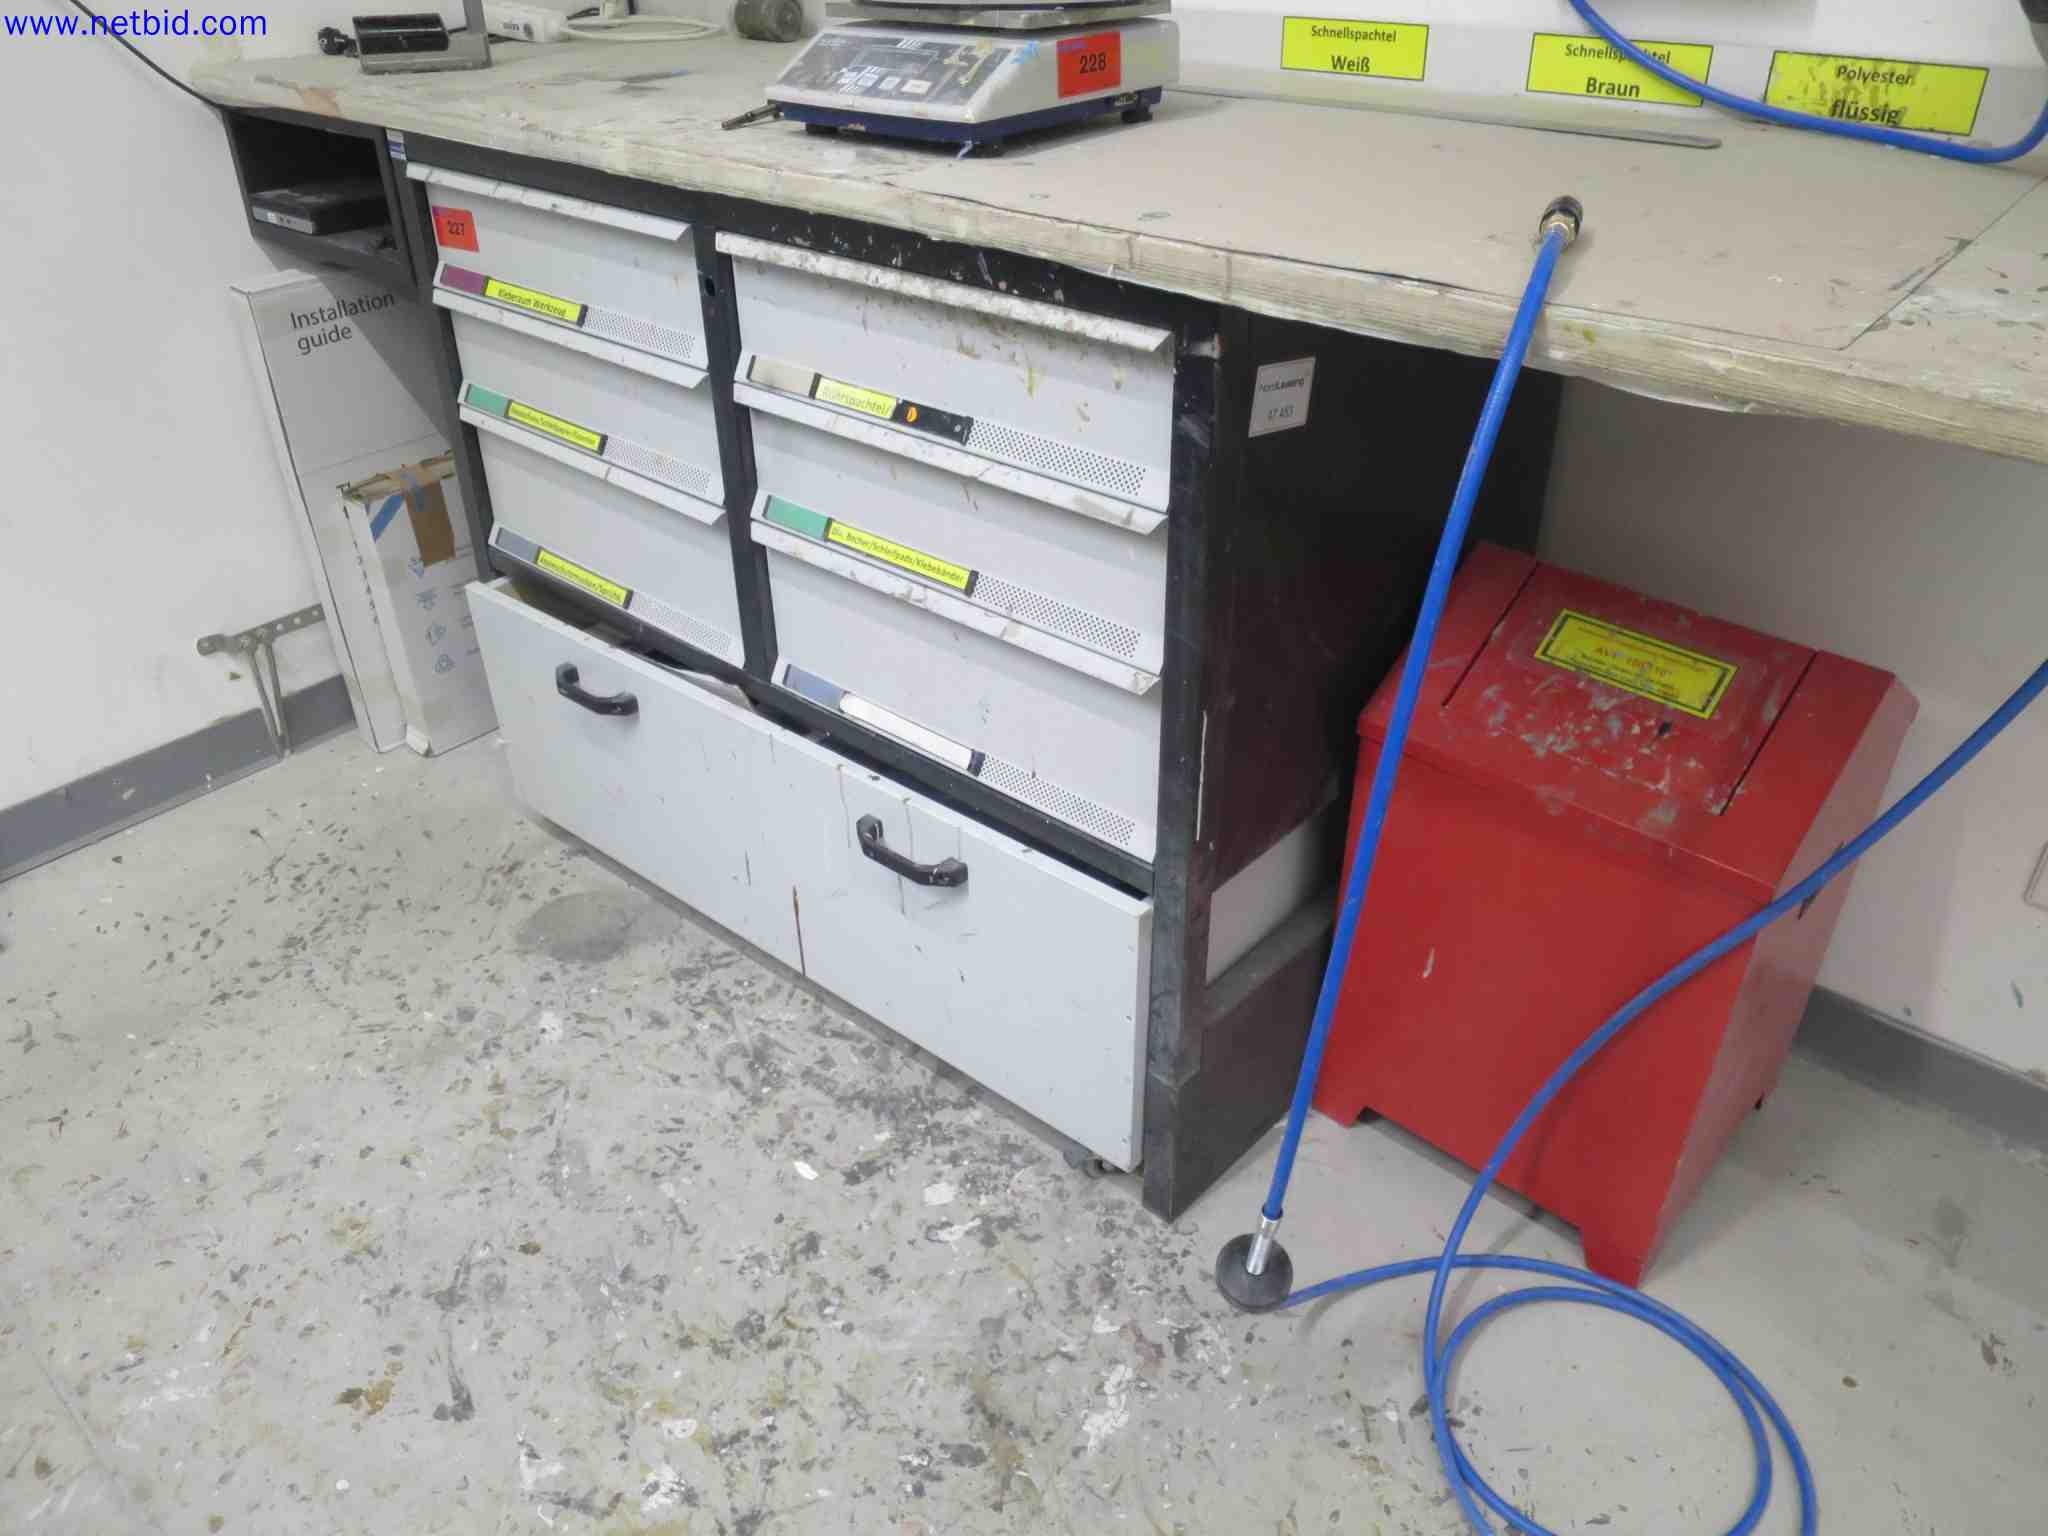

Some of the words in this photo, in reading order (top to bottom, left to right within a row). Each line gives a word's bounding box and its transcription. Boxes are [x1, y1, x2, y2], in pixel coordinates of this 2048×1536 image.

[1311, 25, 1397, 43] Schnellspachtel
[1079, 52, 1107, 74] 228
[1331, 55, 1371, 73] Weiß
[1836, 65, 1913, 86] Polyester
[1585, 77, 1641, 98] Braun
[1829, 98, 1901, 126] flüssig
[447, 219, 465, 236] 227
[290, 293, 396, 329] Installation
[297, 324, 353, 356] guide
